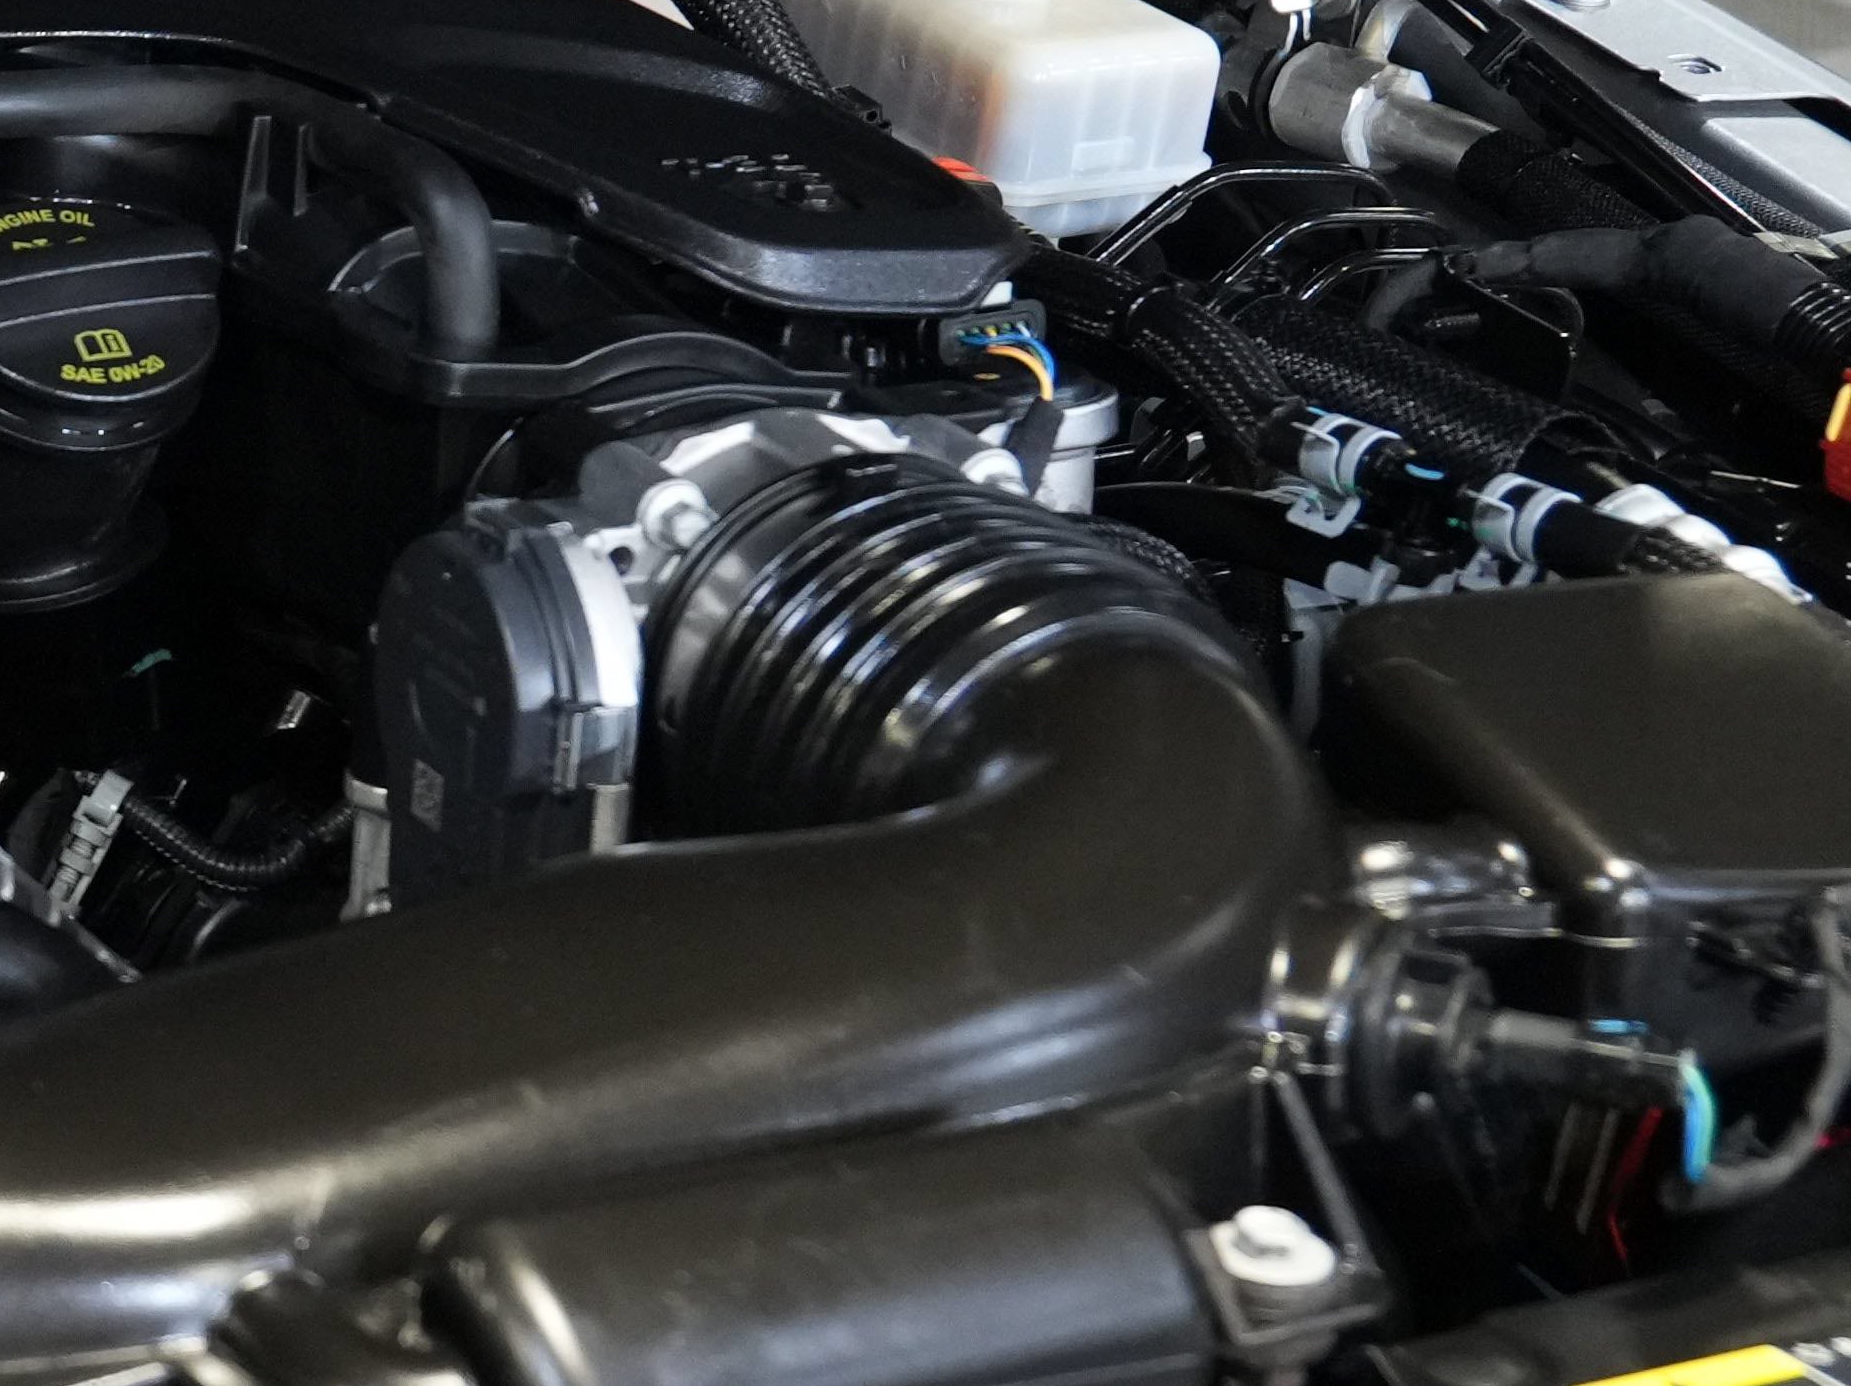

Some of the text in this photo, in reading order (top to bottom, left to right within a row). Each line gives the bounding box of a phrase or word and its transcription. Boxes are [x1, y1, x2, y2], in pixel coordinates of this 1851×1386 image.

[59, 209, 96, 228] OIL
[60, 354, 166, 385] SAE 0W-20
